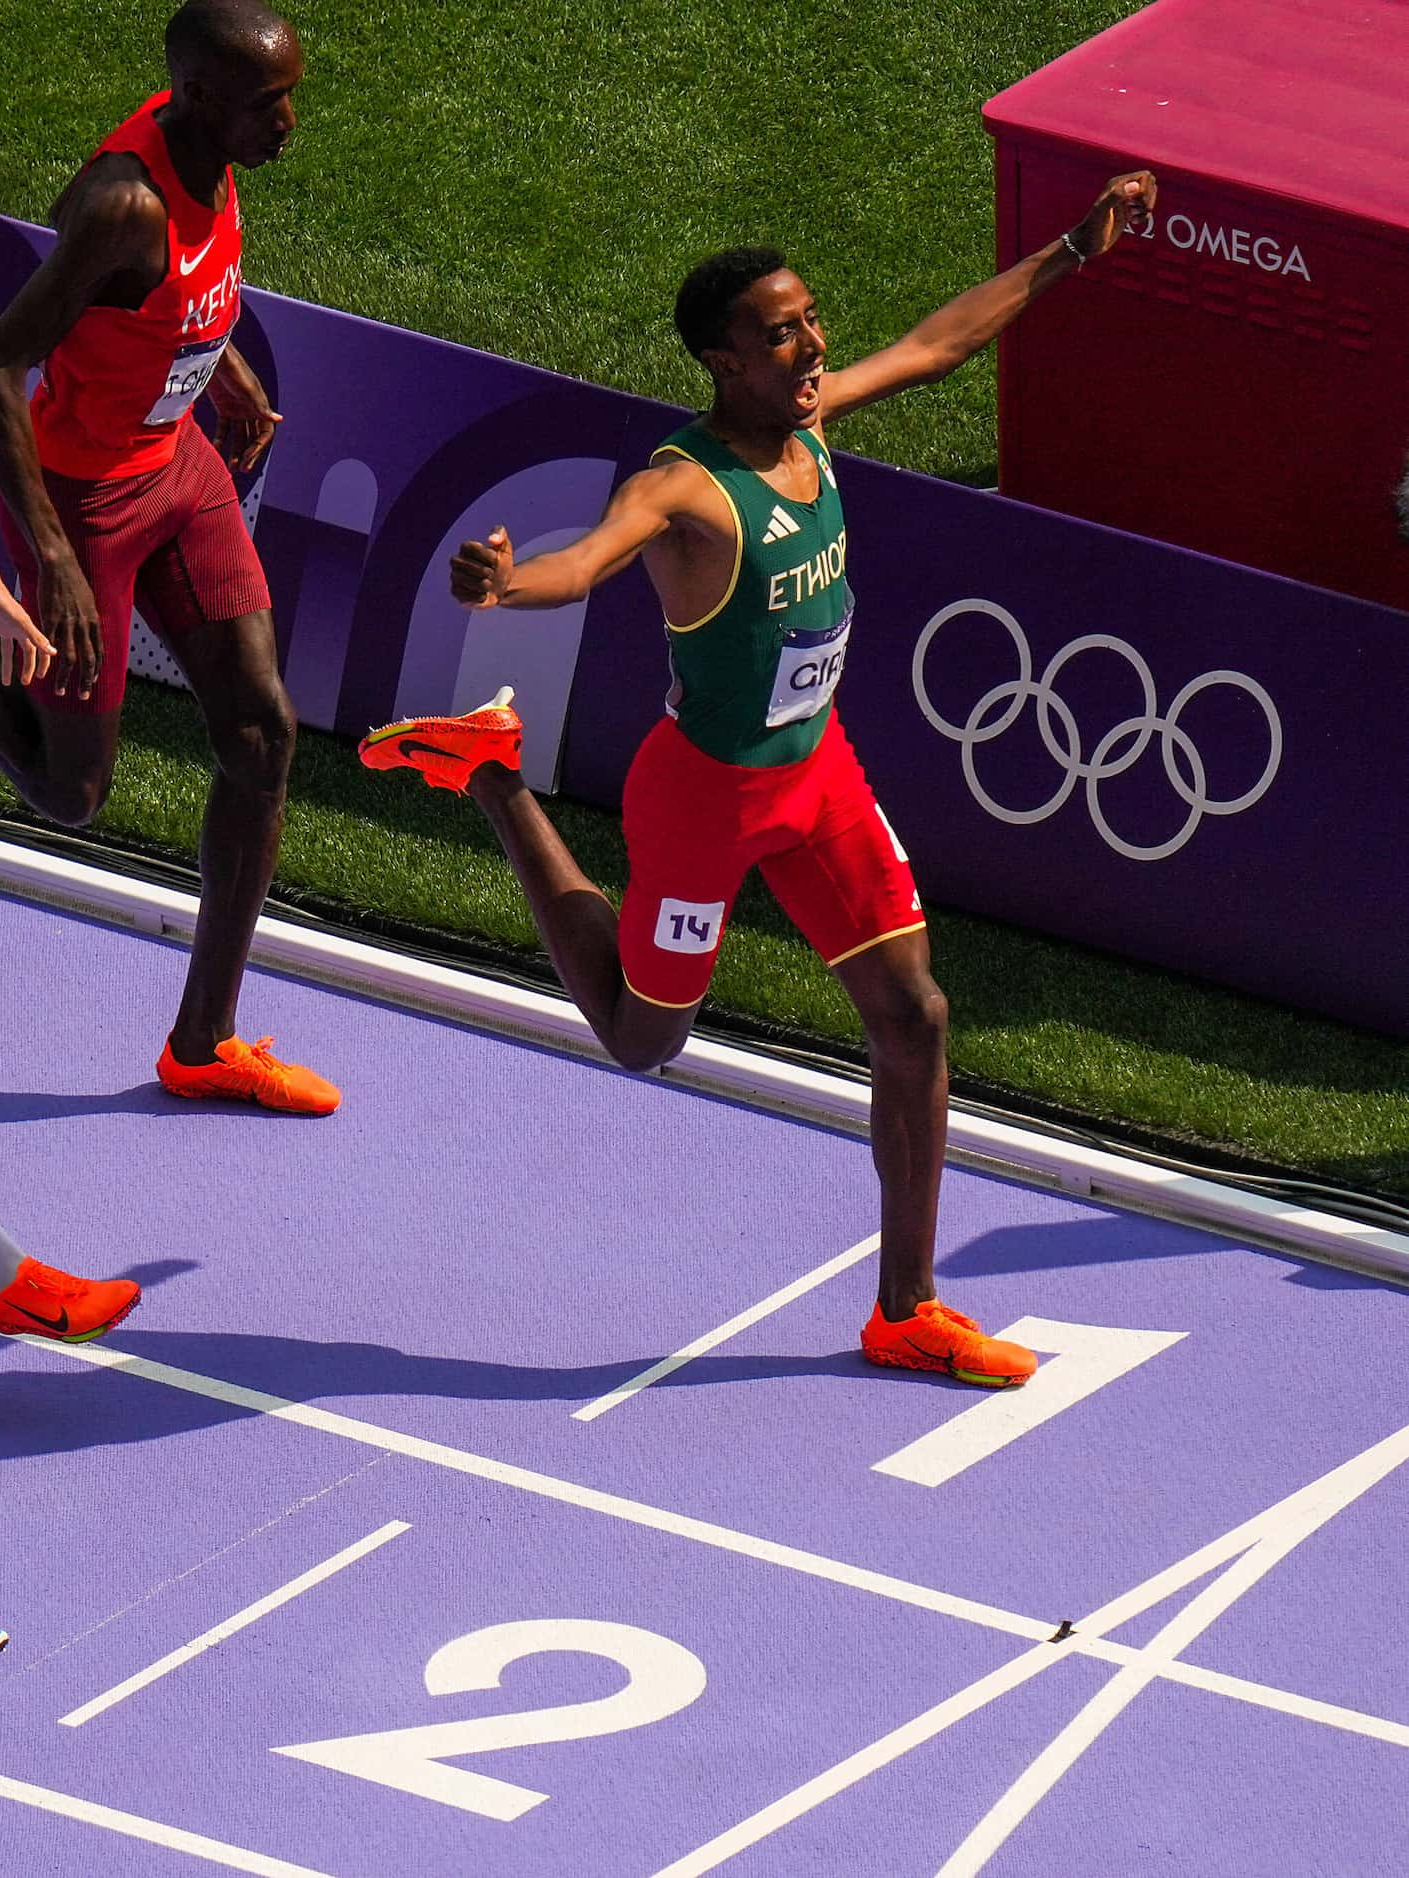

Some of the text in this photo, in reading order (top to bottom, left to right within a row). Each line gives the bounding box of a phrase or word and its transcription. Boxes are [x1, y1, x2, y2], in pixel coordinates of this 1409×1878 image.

[1166, 214, 1312, 282] OMEGA
[670, 914, 711, 943] 14
[871, 1316, 1191, 1487] 1
[268, 1618, 708, 1822] 2
